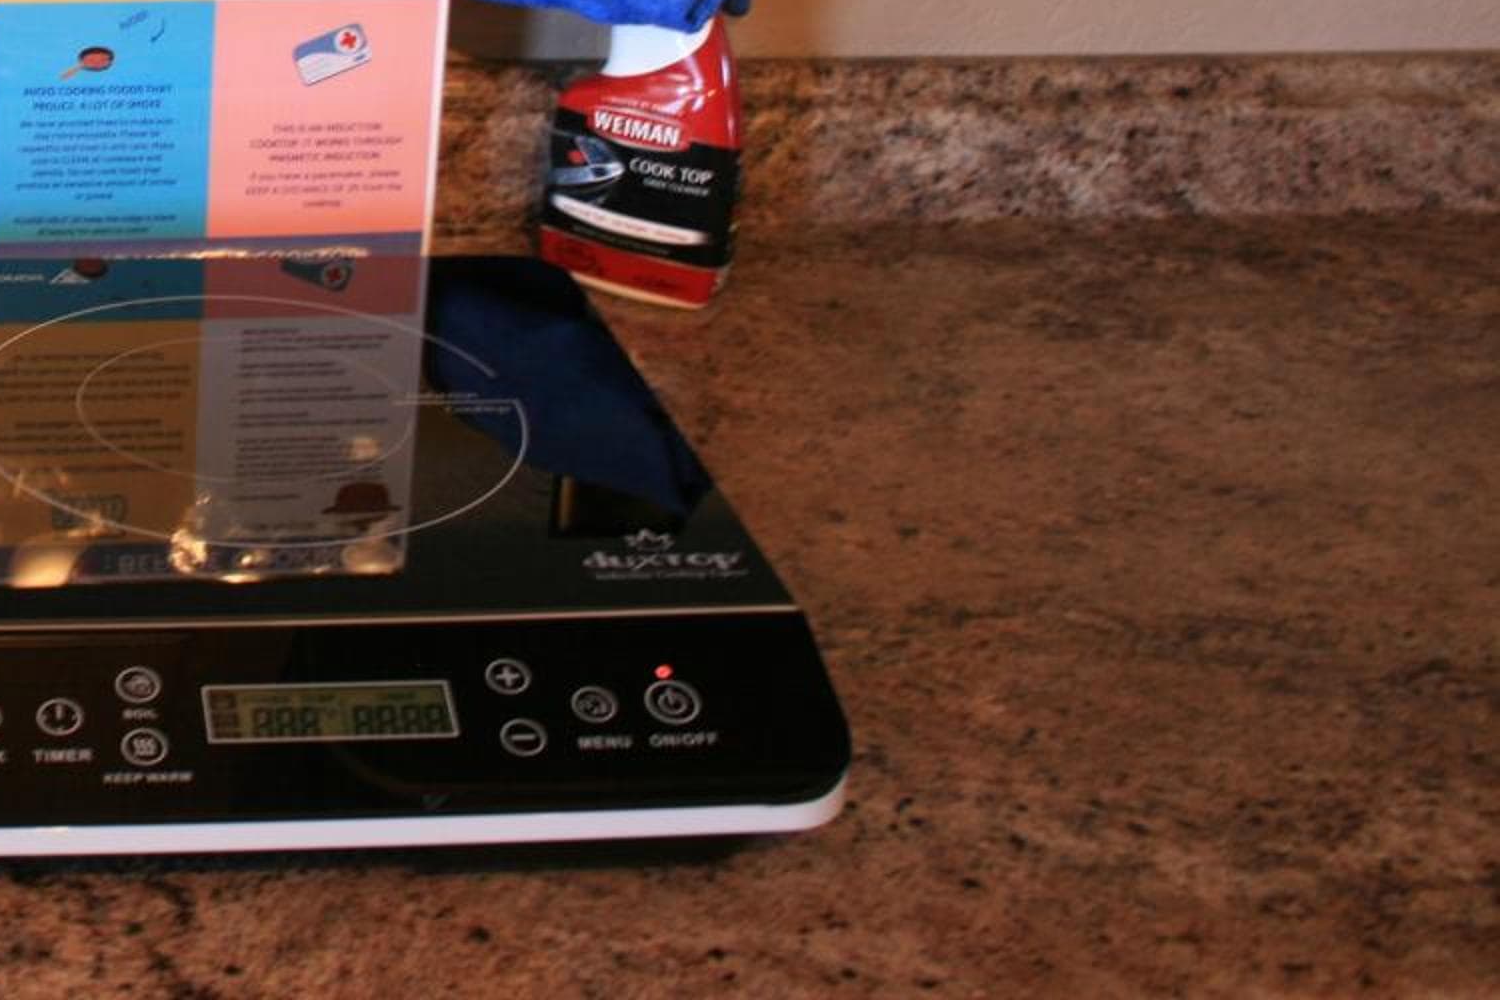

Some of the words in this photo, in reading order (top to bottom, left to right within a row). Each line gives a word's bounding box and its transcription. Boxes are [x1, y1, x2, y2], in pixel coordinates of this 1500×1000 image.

[593, 110, 681, 147] WEIMAN
[629, 156, 677, 180] COOK
[680, 166, 714, 185] TOP
[577, 735, 634, 750] MENU
[649, 731, 719, 748] ON/OFF
[32, 748, 92, 763] TIMER
